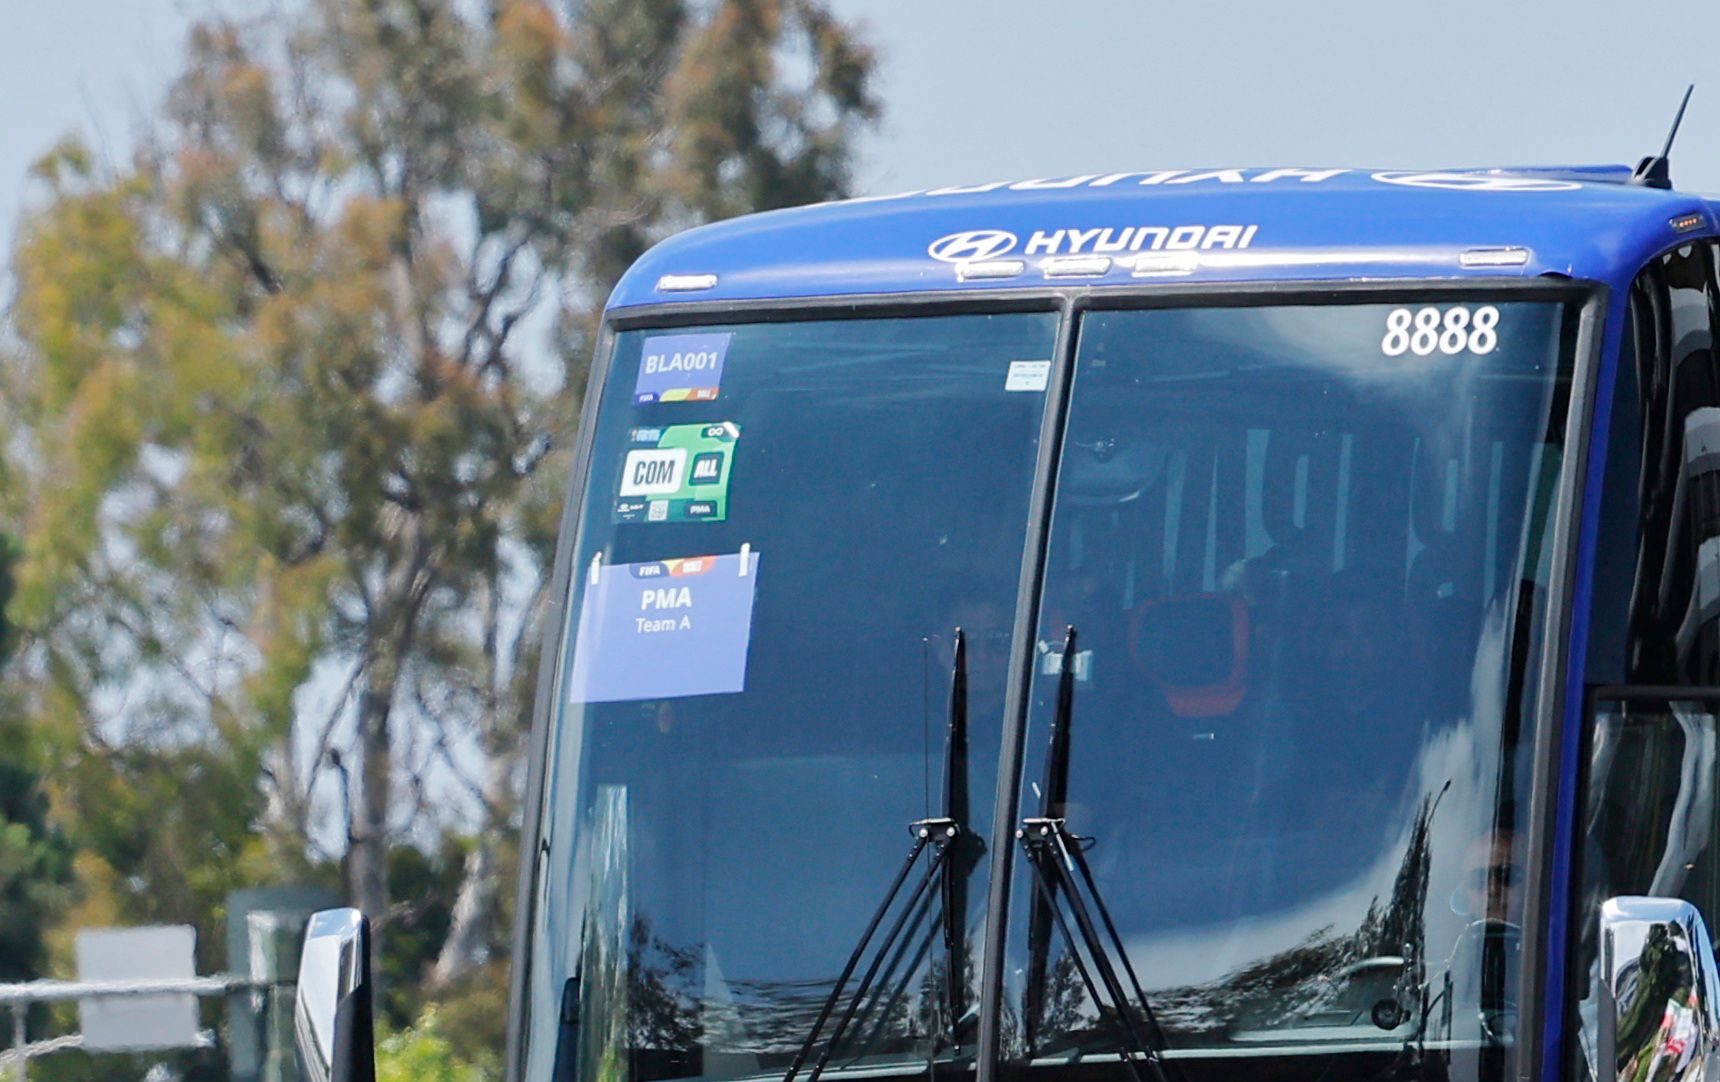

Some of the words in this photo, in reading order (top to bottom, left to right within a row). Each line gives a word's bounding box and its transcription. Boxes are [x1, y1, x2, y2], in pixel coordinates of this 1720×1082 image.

[1025, 225, 1258, 253] HYUNDAI
[1381, 305, 1500, 356] 8888
[645, 351, 718, 374] BLA001
[633, 460, 676, 485] COM
[693, 459, 718, 478] ALL
[690, 505, 711, 514] PMA
[639, 565, 661, 576] FIFA
[641, 586, 692, 611] PMA
[635, 617, 677, 634] Team
[679, 614, 691, 631] A
